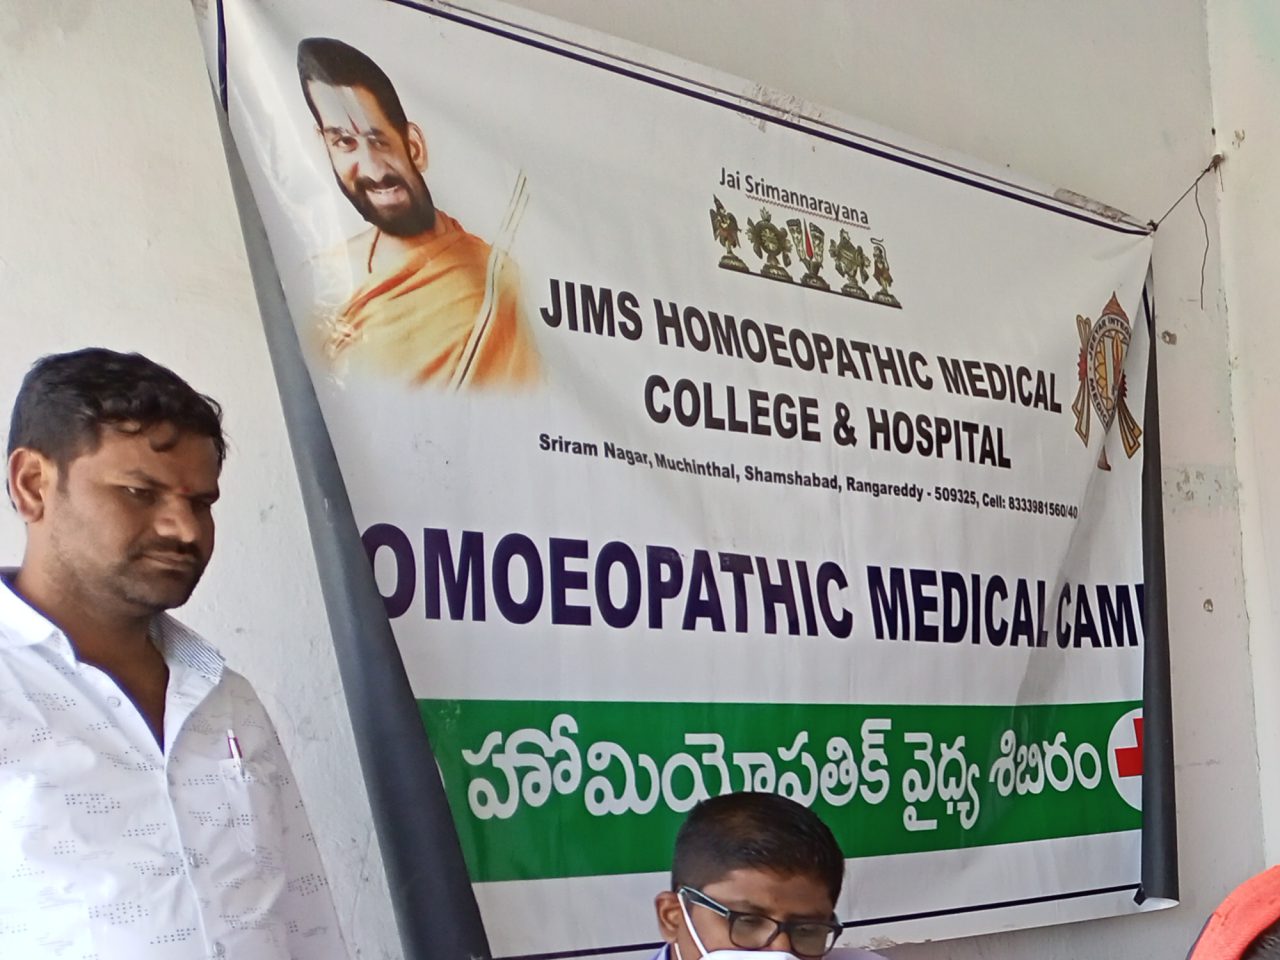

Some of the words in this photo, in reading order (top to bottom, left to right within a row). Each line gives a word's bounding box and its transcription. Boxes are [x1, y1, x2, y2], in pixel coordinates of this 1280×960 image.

[720, 167, 740, 190] Jai
[745, 175, 869, 221] Srimannarayana
[539, 278, 643, 341] JIMS
[653, 298, 933, 391] HOMOEOPATHIC
[937, 356, 1062, 413] MEDICAL
[644, 374, 822, 443] COLLEGE
[833, 402, 857, 447] &
[866, 407, 1012, 468] HOSPITAL
[539, 433, 598, 457] Sriram
[604, 442, 653, 468] Nagar,
[655, 453, 741, 483] Muchinthal,
[744, 465, 843, 494] Shamshabad,
[846, 476, 924, 501] Rangareddy
[934, 486, 980, 509] 509325,
[982, 493, 1006, 509] Cell:
[867, 565, 1048, 647] MEDICAL
[902, 731, 981, 831] వైద్య
[988, 729, 1102, 797] శిబిరం
